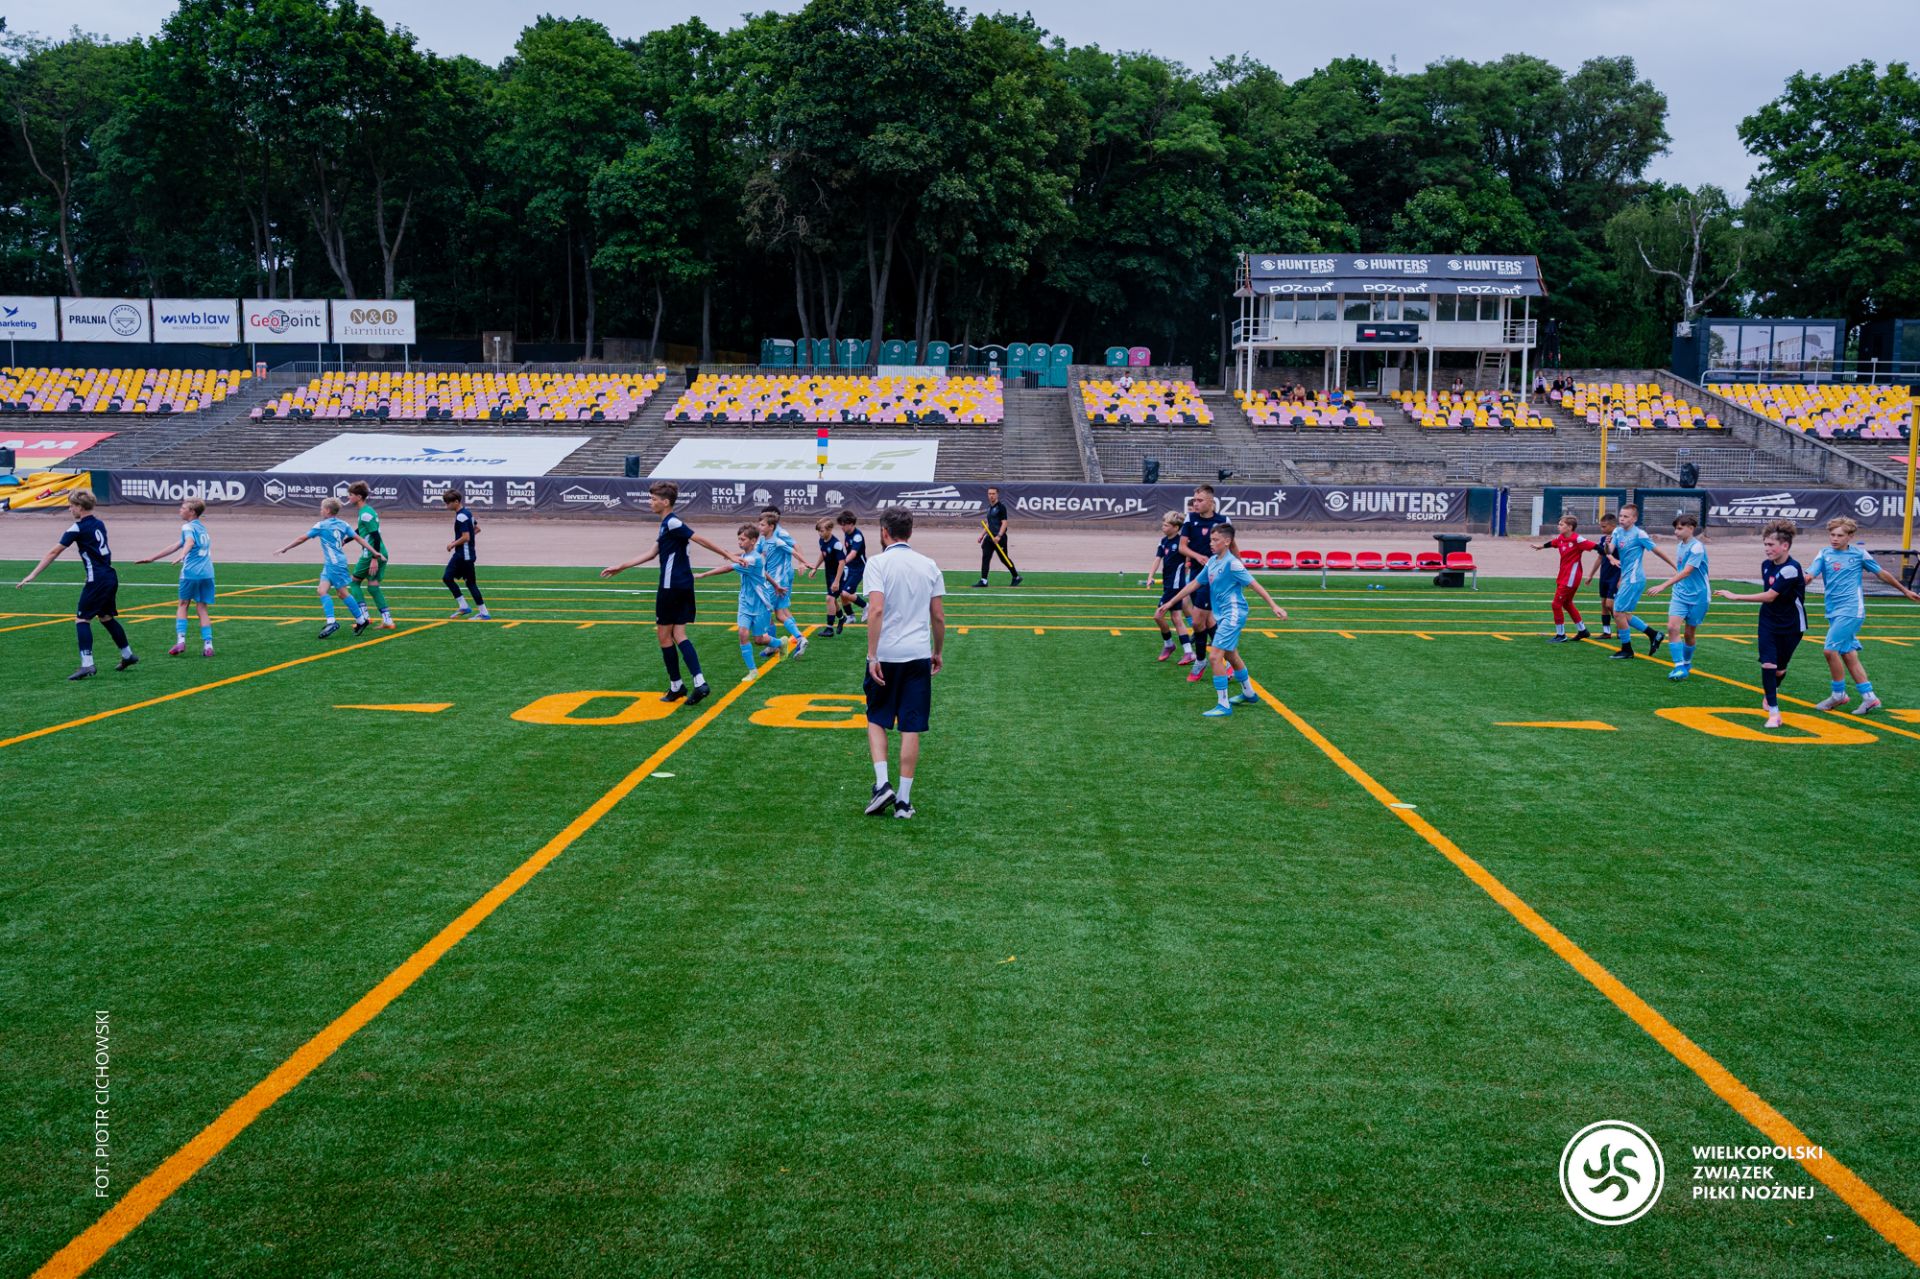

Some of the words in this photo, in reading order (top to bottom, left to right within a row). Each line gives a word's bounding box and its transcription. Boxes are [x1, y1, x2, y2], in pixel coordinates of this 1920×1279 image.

[1277, 259, 1335, 270] HUNTERS
[1370, 259, 1428, 270] HUNTERS
[1464, 260, 1522, 272] HUNTERS
[69, 315, 107, 324] PRALNIA
[250, 309, 321, 327] GeoPoint
[344, 326, 405, 336] Furniture
[287, 485, 328, 494] MP-SPED
[507, 489, 536, 497] TERRAZZO
[711, 487, 734, 496] EKO
[783, 488, 806, 497] EKO
[1352, 491, 1449, 513] HUNTERS
[1406, 512, 1448, 520] SECURITY
